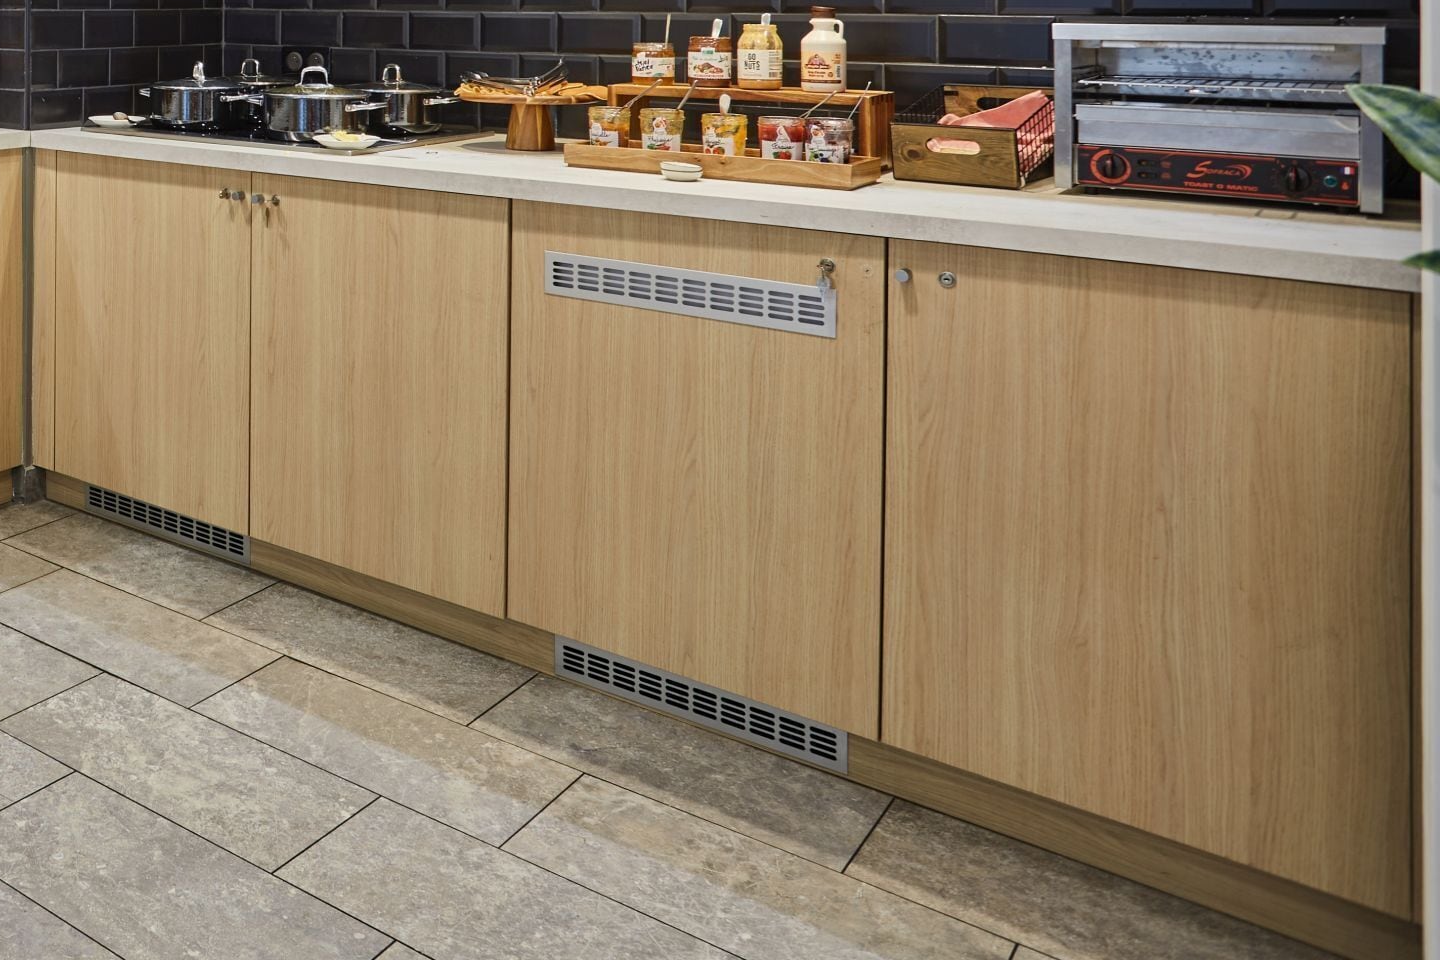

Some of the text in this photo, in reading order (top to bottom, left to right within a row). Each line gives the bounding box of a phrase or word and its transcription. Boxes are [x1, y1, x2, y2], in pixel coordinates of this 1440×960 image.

[747, 53, 757, 61] GO
[743, 60, 761, 71] NUTS
[1184, 181, 1214, 189] TOAST
[1226, 184, 1258, 192] MATIC
